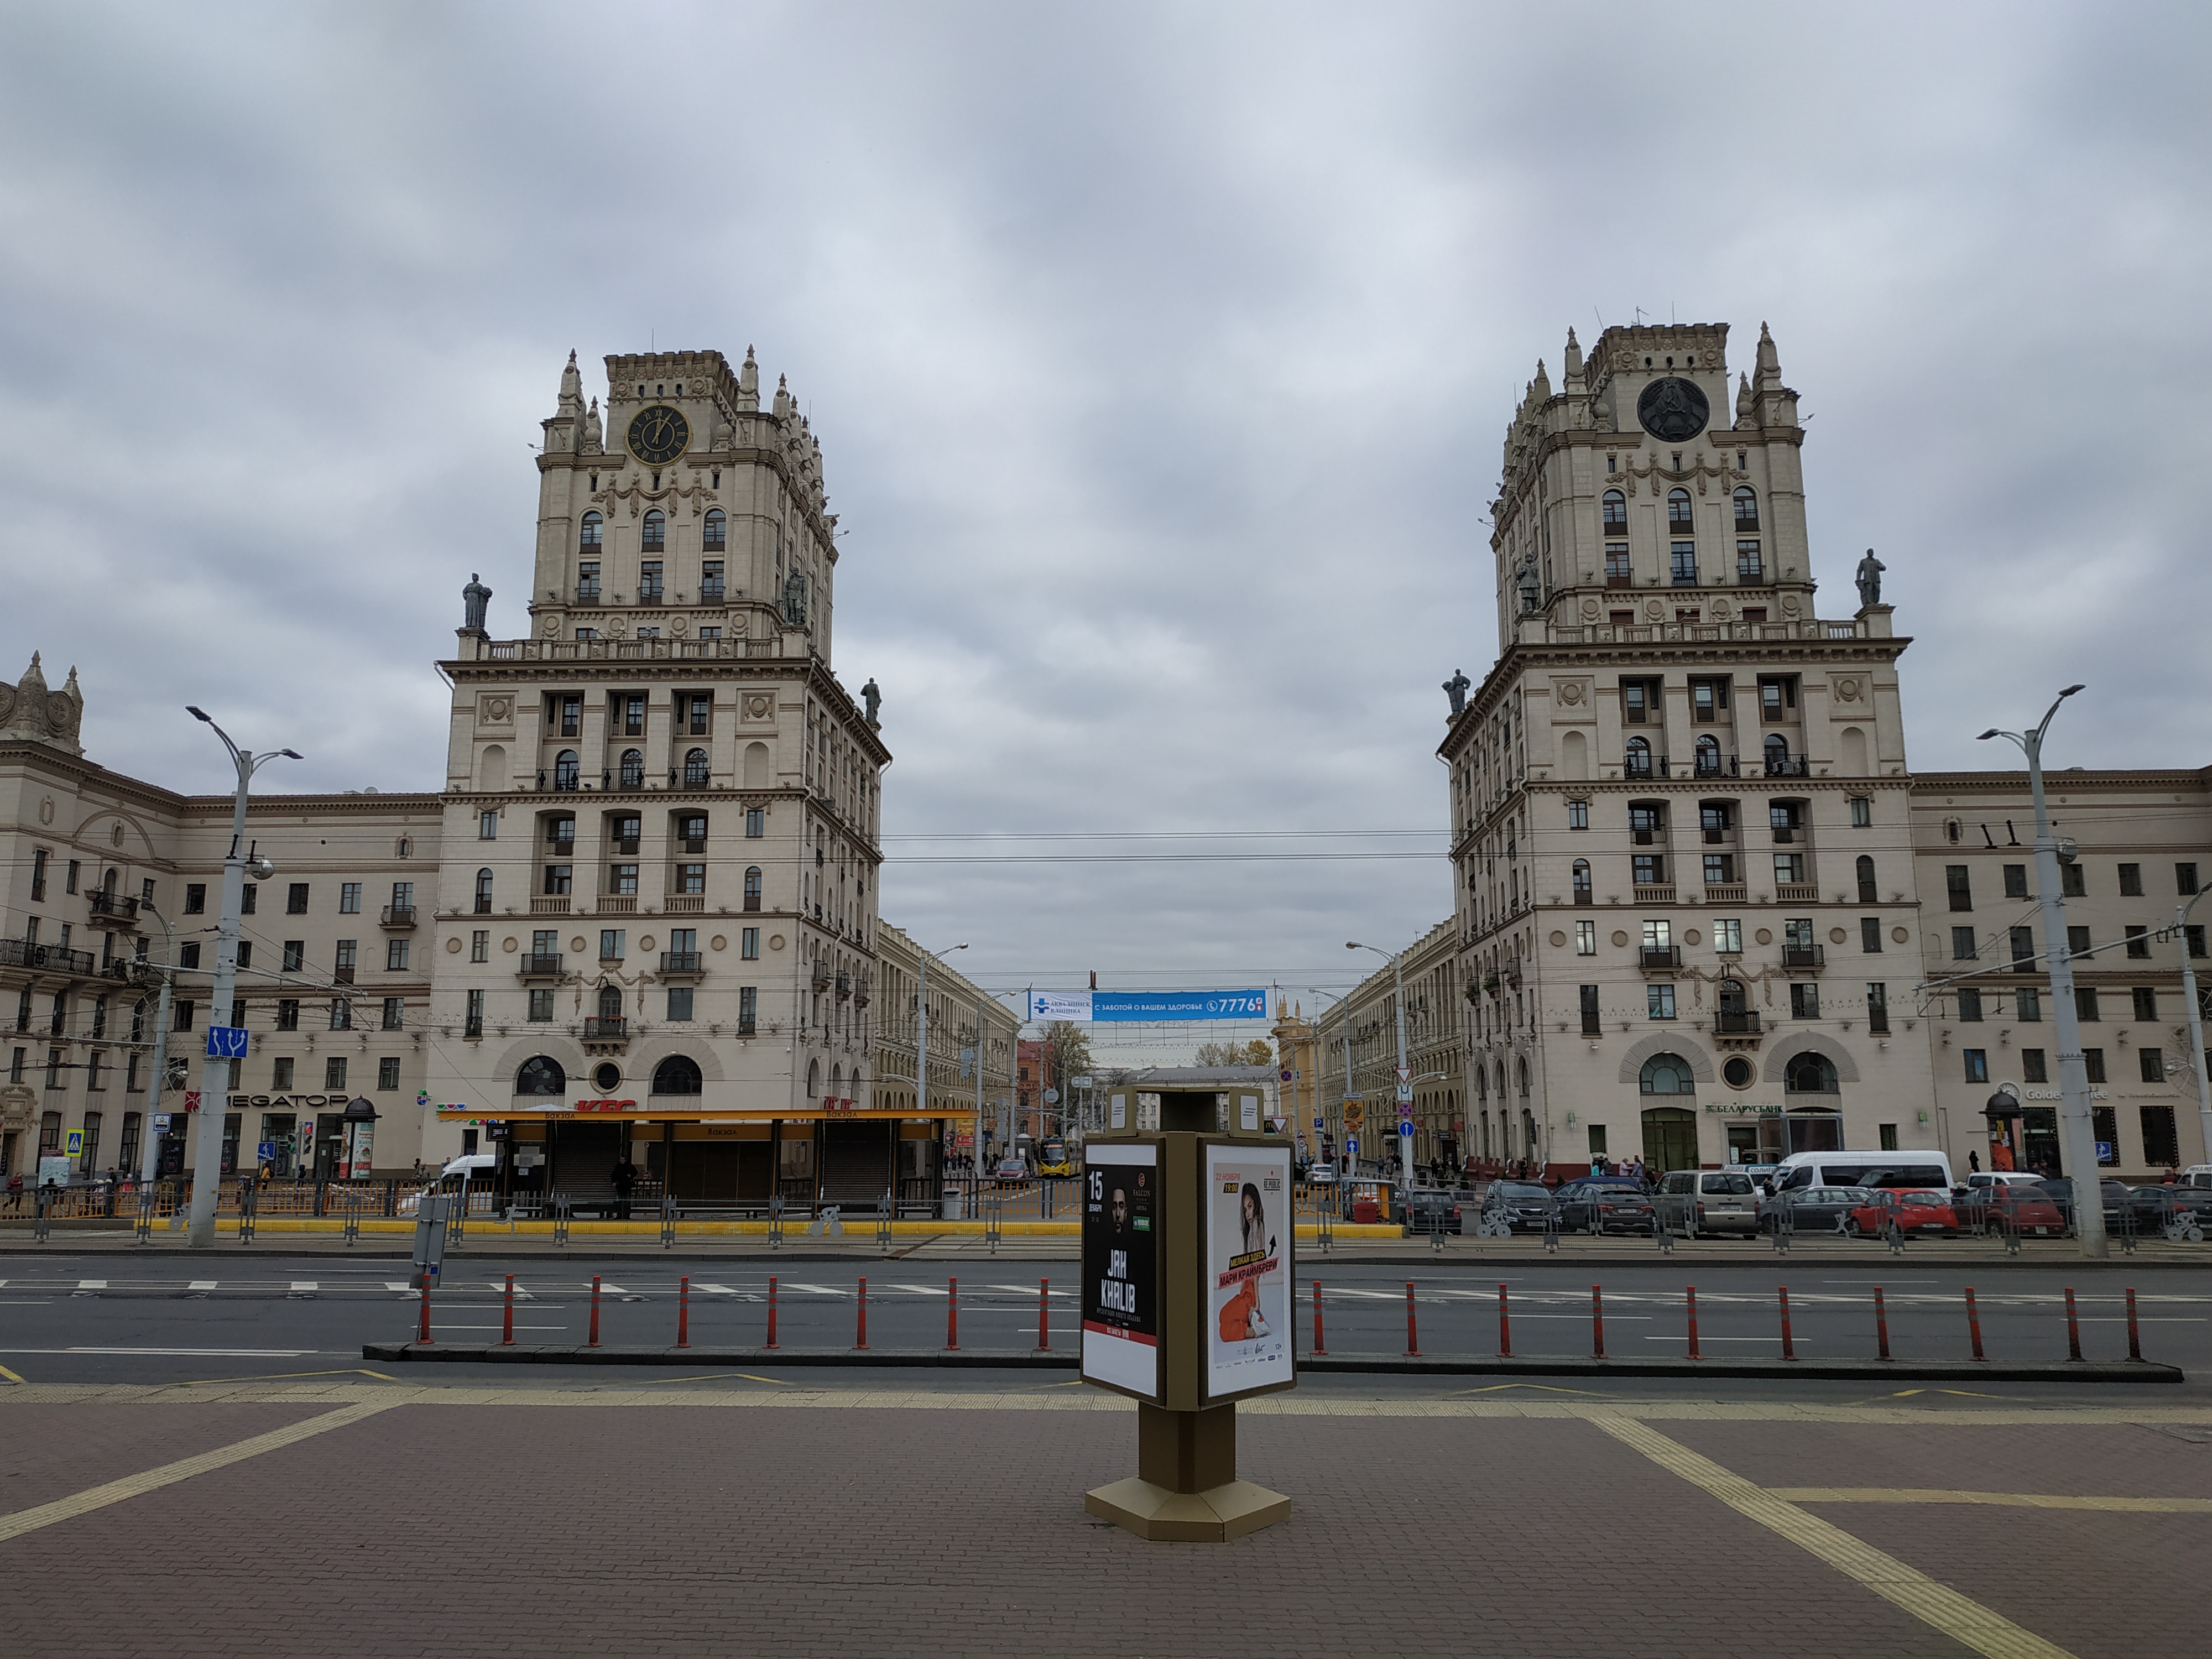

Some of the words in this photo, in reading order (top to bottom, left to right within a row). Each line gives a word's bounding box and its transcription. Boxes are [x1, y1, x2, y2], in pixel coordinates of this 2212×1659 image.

[1219, 998, 1256, 1013] 7776
[2026, 1089, 2063, 1099] Golde
[1316, 1119, 1322, 1127] P
[1222, 1173, 1240, 1181] НОЯБРЯ
[1264, 1180, 1281, 1189] RE:PUBLIC
[1088, 1170, 1103, 1201] 15
[1225, 1184, 1238, 1192] 19:00
[1108, 1249, 1127, 1279] JAH
[1230, 1255, 1250, 1267] МЕЛКАЯ
[1250, 1250, 1265, 1263] ЗДЕСЬ
[1220, 1274, 1237, 1287] МАРИ
[1238, 1259, 1277, 1281] КРАЙМБРЕРИ
[1101, 1279, 1135, 1313] KHALIB
